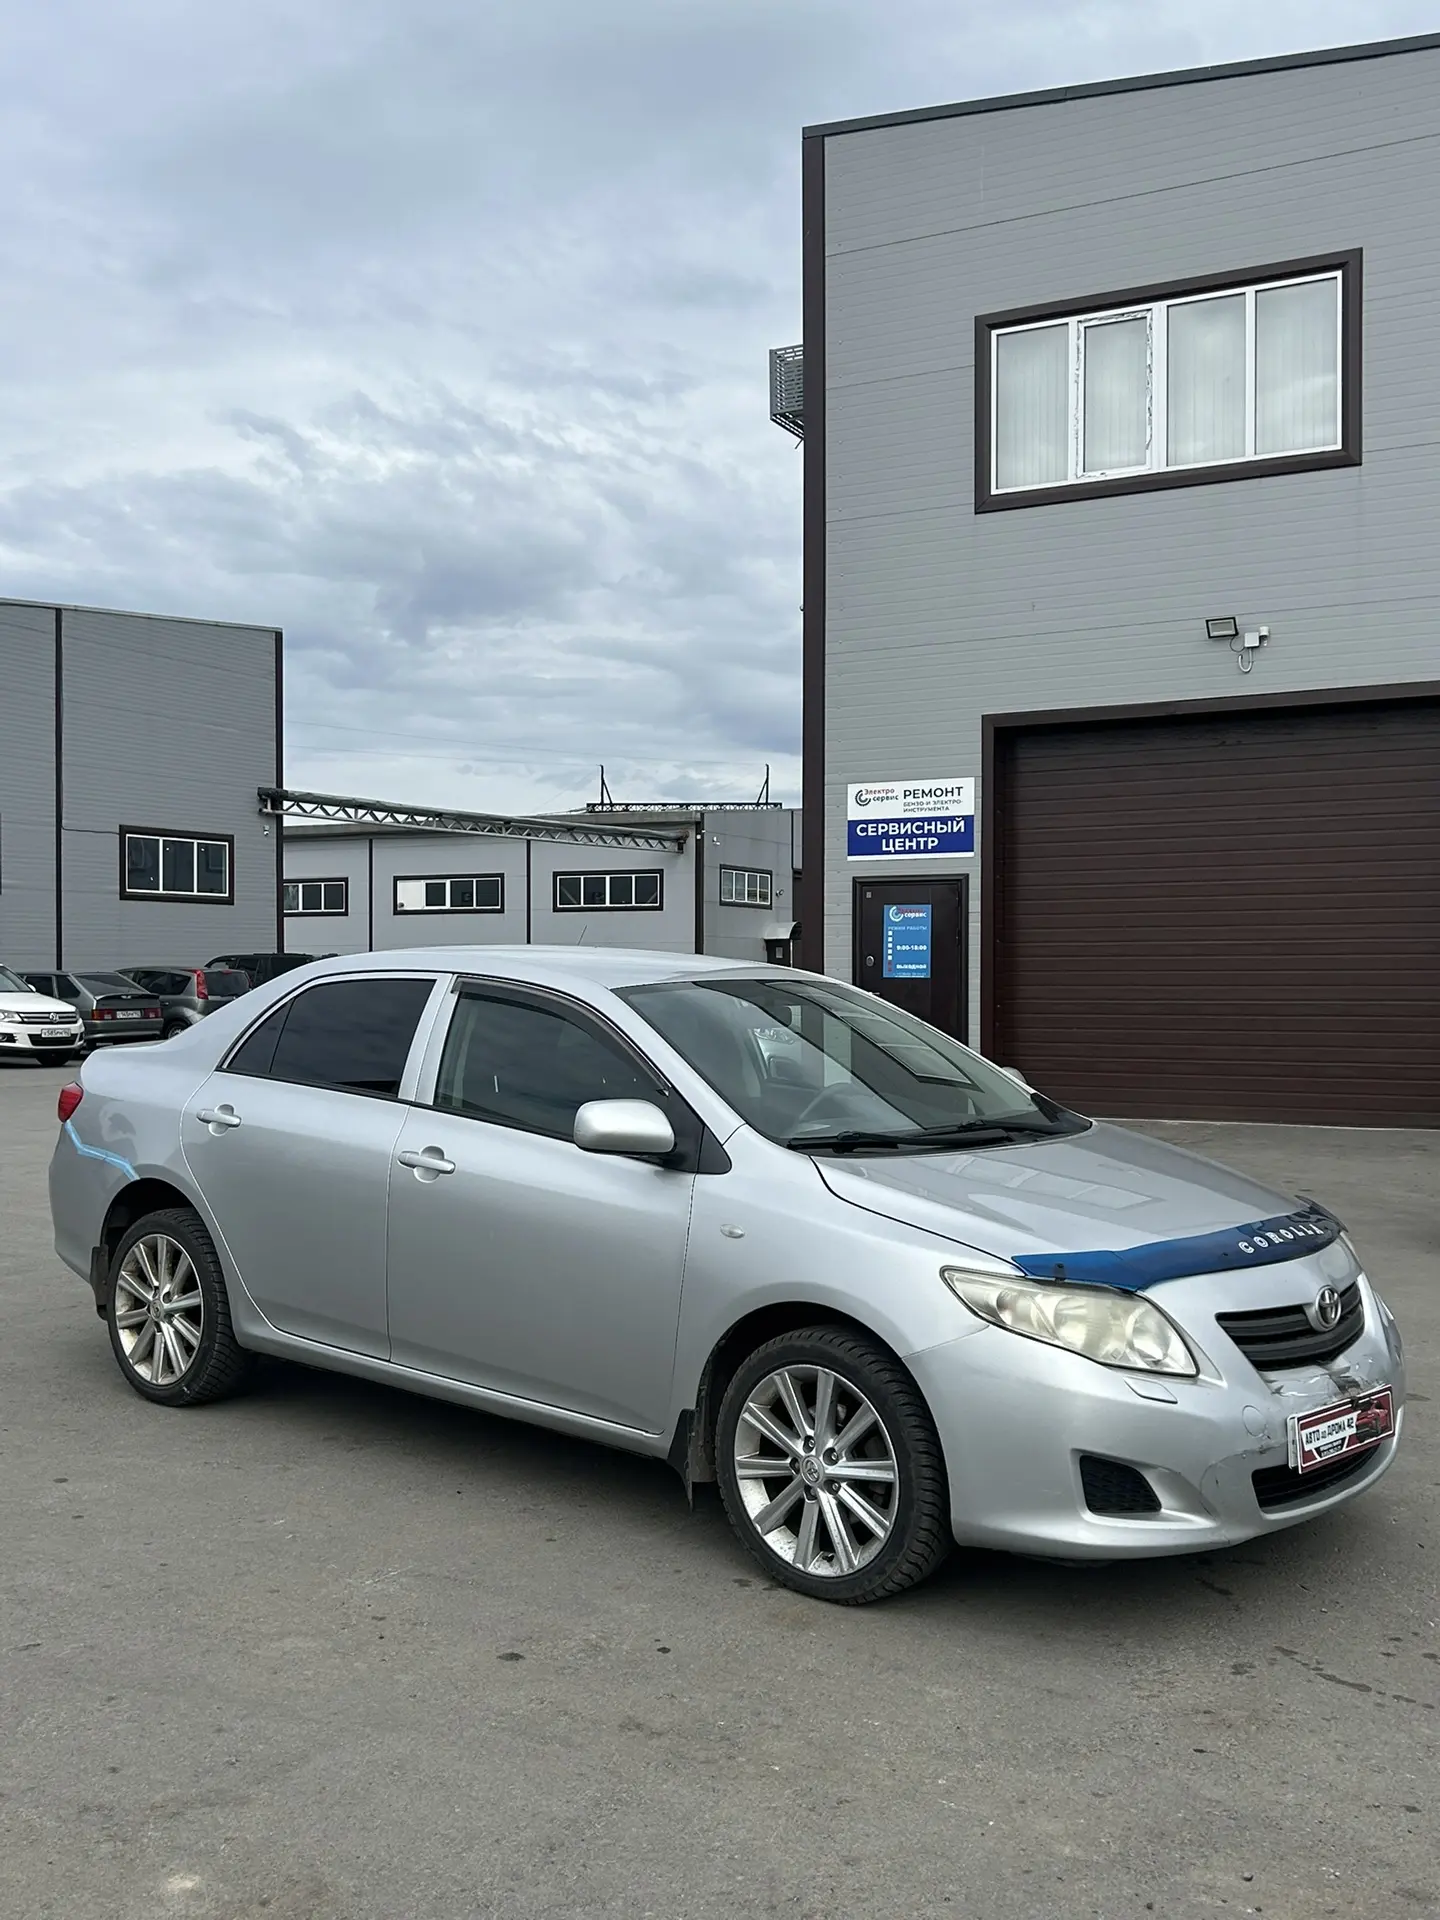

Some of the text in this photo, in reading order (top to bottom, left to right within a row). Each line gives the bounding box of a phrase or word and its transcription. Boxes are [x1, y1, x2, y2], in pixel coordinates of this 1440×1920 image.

[864, 788, 895, 797] Электро
[872, 794, 899, 803] сервис
[903, 786, 964, 799] РЕМОНТ
[856, 817, 965, 836] СЕРВИСНЫЙ
[882, 837, 939, 853] ЦЕНТР
[1238, 1223, 1325, 1254] COROLLA
[1305, 1429, 1320, 1445] АВТО
